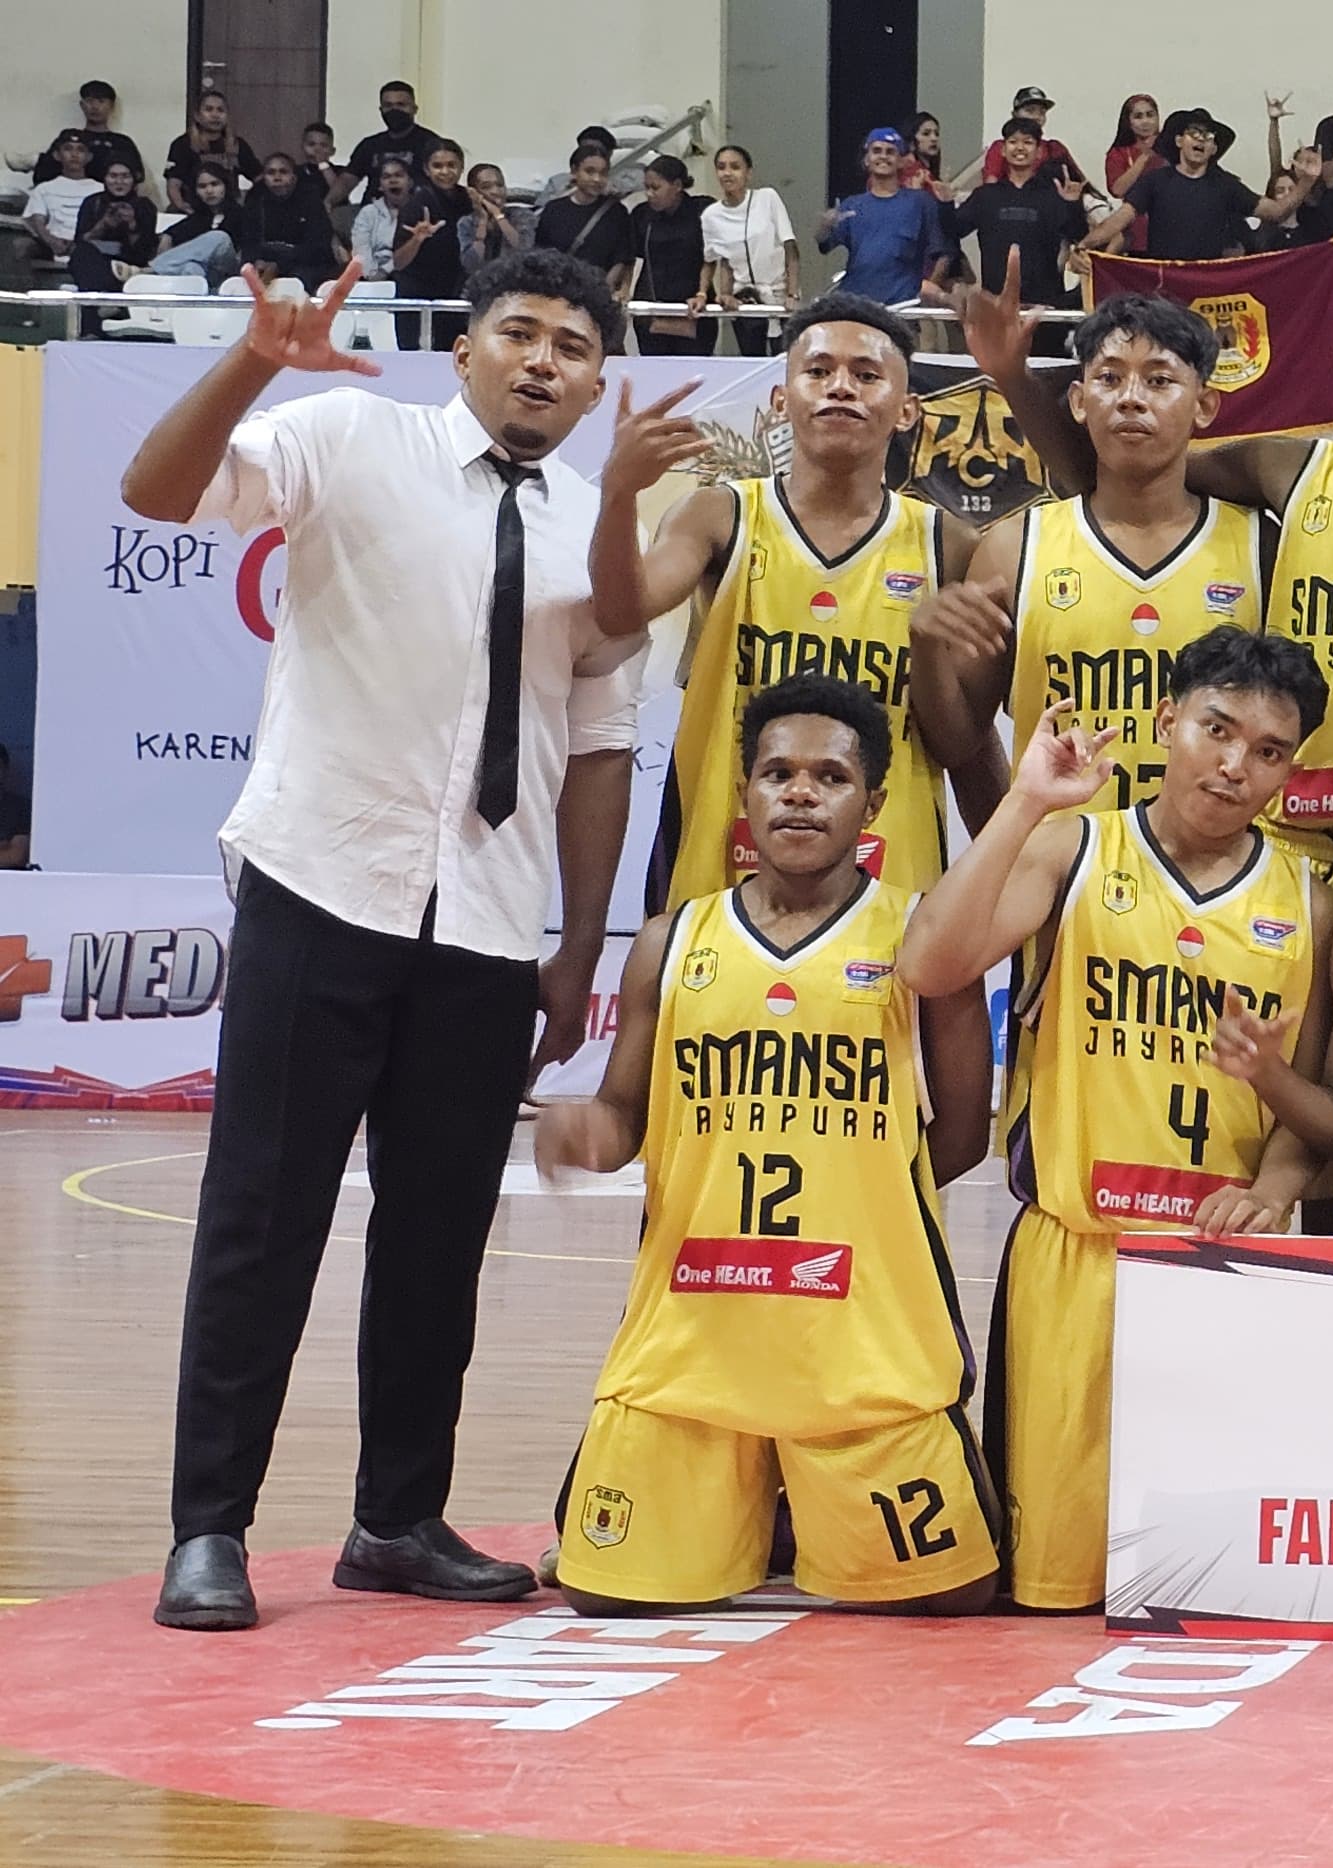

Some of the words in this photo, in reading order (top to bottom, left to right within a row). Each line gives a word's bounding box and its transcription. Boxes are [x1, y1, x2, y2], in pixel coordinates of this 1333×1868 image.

[1045, 648, 1178, 714] SMAN
[1286, 795, 1319, 813] One
[674, 1031, 889, 1105] SMANSA
[696, 1102, 887, 1141] AYAPURA
[1168, 1084, 1209, 1166] 4
[738, 1153, 803, 1236] 12
[1096, 1189, 1130, 1209] One
[1133, 1193, 1194, 1218] HEART.
[676, 1264, 710, 1283] One
[715, 1265, 773, 1287] HEART.
[789, 1279, 840, 1291] HONDA
[870, 1477, 958, 1562] 12
